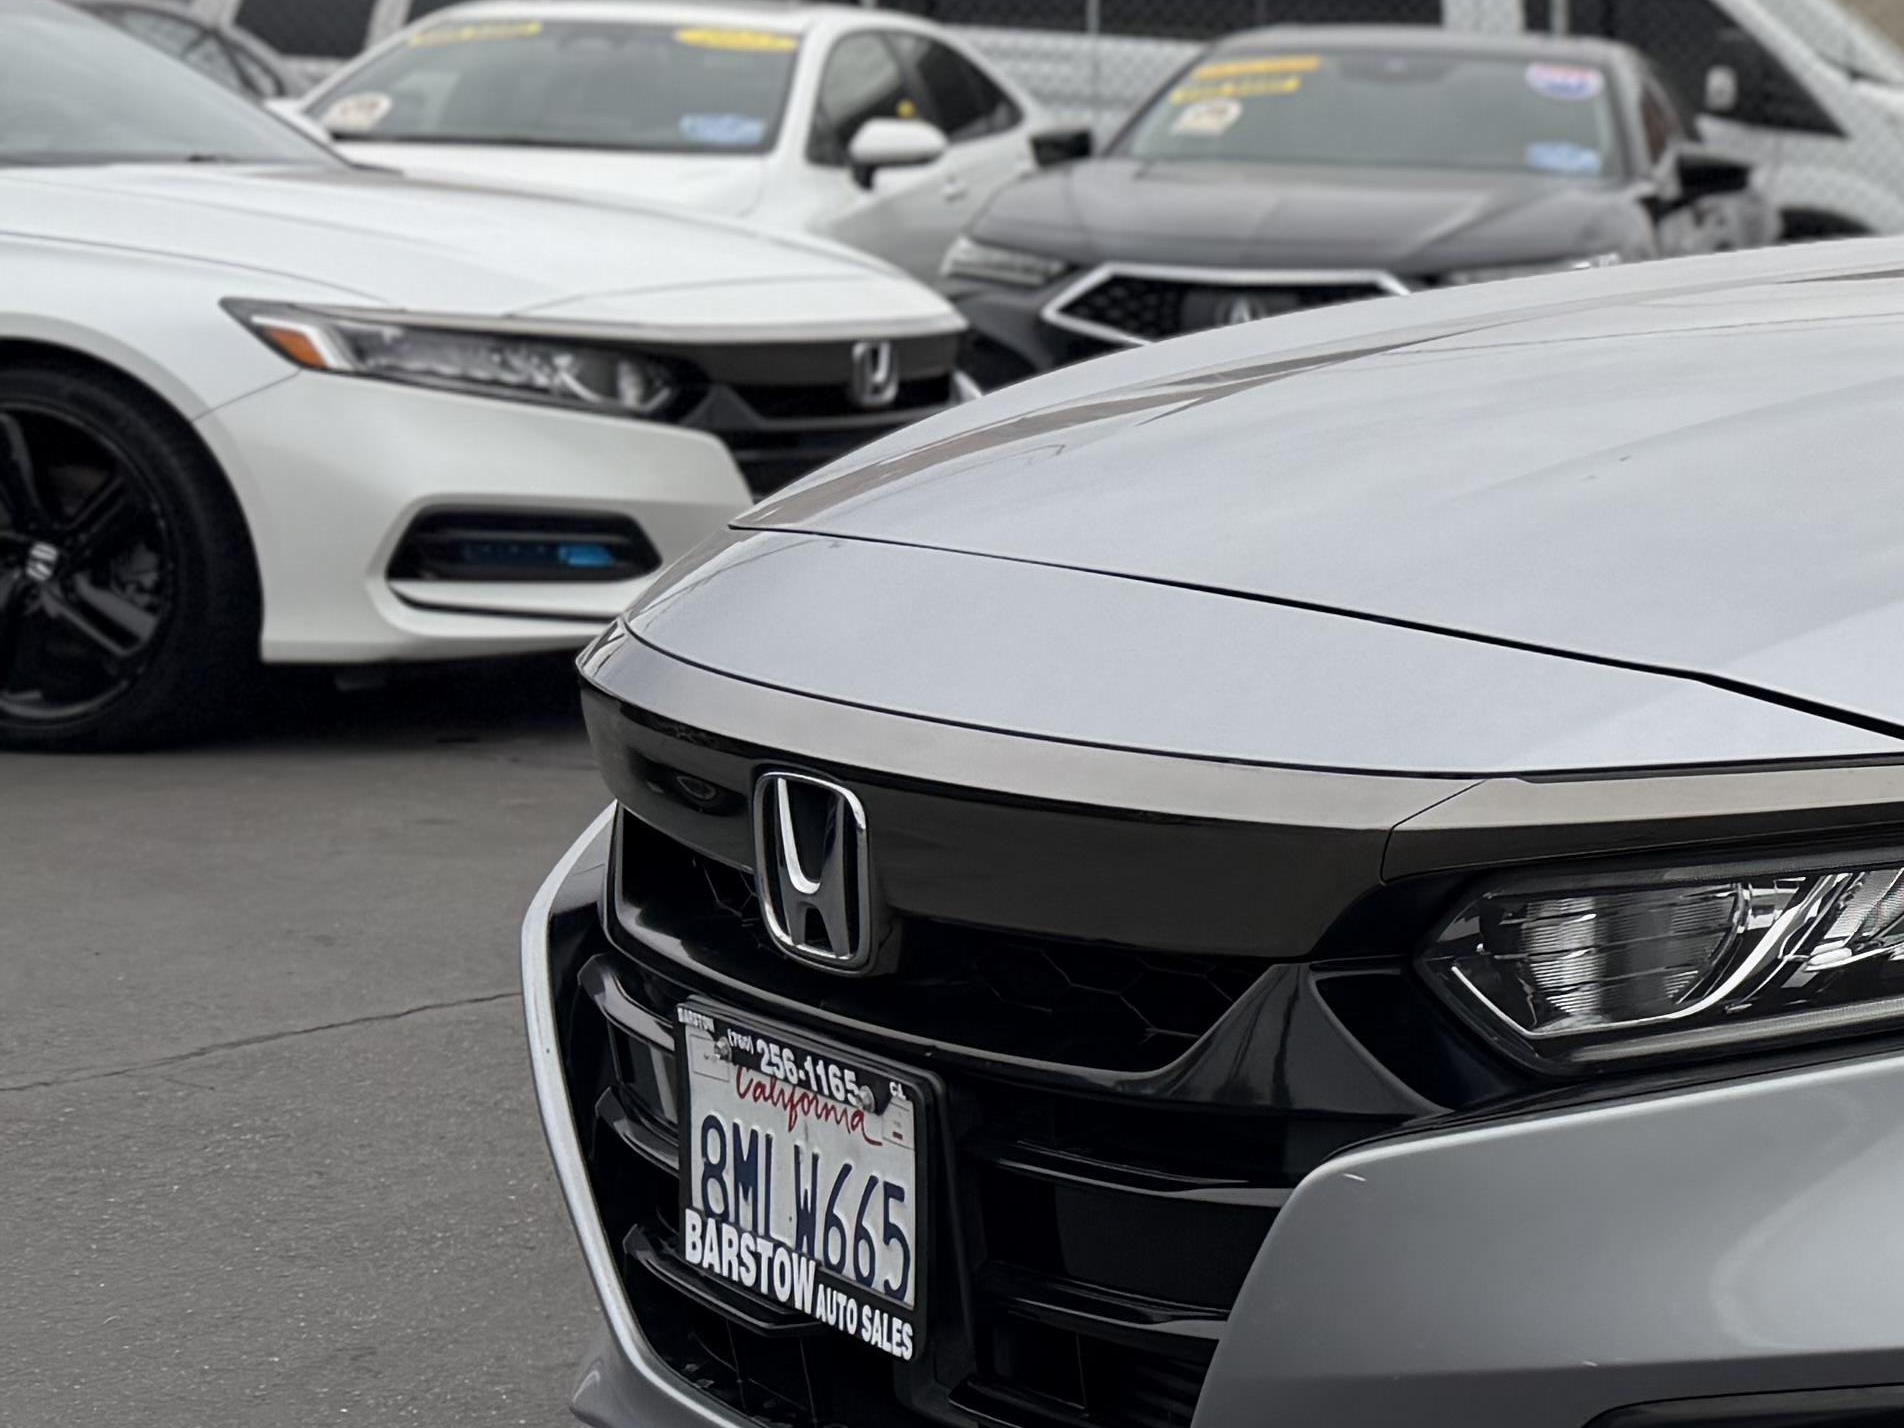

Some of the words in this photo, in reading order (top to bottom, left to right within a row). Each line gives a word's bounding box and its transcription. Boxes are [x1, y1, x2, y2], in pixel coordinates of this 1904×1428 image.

[736, 1065, 882, 1146] California
[756, 1038, 861, 1109] 256-1165
[684, 1208, 816, 1315] BARSTOW
[816, 1282, 858, 1335] AUTO
[861, 1306, 914, 1361] SALES
